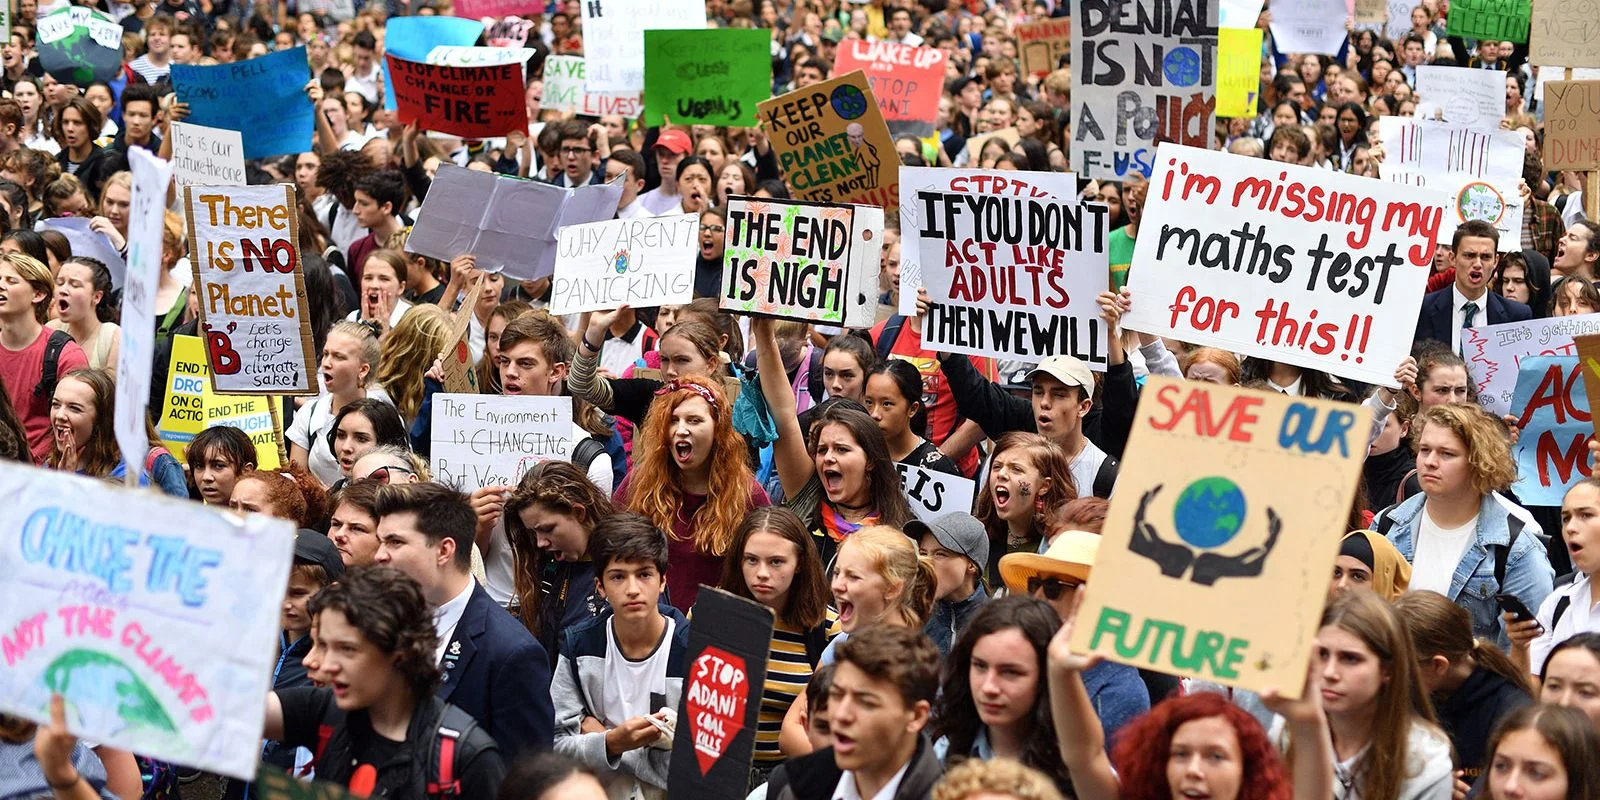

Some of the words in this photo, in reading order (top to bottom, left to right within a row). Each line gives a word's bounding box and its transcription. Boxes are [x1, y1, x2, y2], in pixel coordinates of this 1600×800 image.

[40, 20, 70, 37] SAVE
[71, 12, 89, 25] MY
[1081, 0, 1218, 37] DENIAL
[545, 58, 585, 80] SAVE
[852, 40, 911, 65] WAKE
[914, 49, 942, 69] UP
[1082, 39, 1125, 86] IS
[1134, 38, 1218, 87] NOT
[393, 61, 435, 77] STOP
[441, 65, 512, 81] CLIMATE
[475, 85, 496, 97] OR
[583, 92, 638, 116] LIVES
[880, 98, 912, 115] ANI
[424, 94, 492, 124] FIRE
[767, 93, 828, 132] KEEP
[1075, 102, 1105, 141] A
[1116, 90, 1217, 149] POLICY
[172, 124, 194, 148] This
[198, 136, 208, 152] is
[212, 140, 234, 157] our
[786, 122, 825, 146] OUR
[1550, 119, 1577, 134] TOO
[780, 131, 852, 172] PLANET
[222, 166, 242, 182] one
[791, 154, 860, 190] CLEAN
[837, 175, 866, 196] NOT
[950, 175, 1058, 200] STRIK
[199, 194, 289, 230] There
[918, 191, 964, 240] IF
[964, 194, 1022, 246] YOU
[1029, 200, 1109, 253] DON'T
[1162, 158, 1221, 205] i'm
[1232, 171, 1376, 249] missing
[1382, 201, 1442, 267] my
[559, 226, 607, 258] WHY
[614, 219, 697, 250] AREN'T
[730, 211, 781, 251] THE
[792, 216, 847, 260] END
[207, 241, 235, 272] IS
[240, 238, 297, 274] NO
[604, 250, 644, 274] YOU
[945, 238, 997, 267] ACT
[1012, 245, 1066, 272] LIKE
[1156, 222, 1296, 283] maths
[1307, 234, 1404, 305] test
[553, 270, 693, 309] PANICKING!
[727, 258, 758, 301] IS
[768, 261, 843, 311] NIGH
[949, 266, 1070, 308] ADULTS
[207, 283, 295, 319] Planet
[249, 323, 282, 335] Let's
[926, 303, 984, 349] THEN
[989, 310, 1028, 355] WE
[1028, 313, 1106, 364] WILL
[1169, 286, 1239, 333] for
[1256, 299, 1373, 363] this!!
[1496, 326, 1532, 347] It's
[246, 336, 292, 353] change
[256, 351, 275, 362] for
[176, 361, 199, 374] END
[244, 361, 299, 375] climate
[253, 371, 299, 387] sake!
[171, 395, 188, 406] ON
[208, 405, 231, 418] END
[234, 401, 255, 414] THE
[442, 399, 466, 418] The
[475, 402, 558, 425] Environment
[1516, 364, 1593, 429] AC
[169, 408, 203, 421] ACTIO
[1149, 384, 1264, 443] SAVE
[1278, 402, 1354, 458] OUR
[453, 429, 465, 444] IS
[470, 429, 567, 456] CHANGING
[438, 458, 468, 490] But
[473, 465, 508, 488] We're
[908, 469, 945, 512] IS
[146, 535, 224, 608] THE
[560, 579, 568, 600] Nikon
[1089, 606, 1249, 680] FUTURE
[1, 611, 48, 667] NOT
[58, 605, 117, 639] THE
[120, 622, 214, 724] CLIMATE
[697, 654, 745, 691] STOP
[687, 679, 737, 718] ADANI
[695, 729, 724, 752] KILLS
[697, 713, 727, 737] COAL
